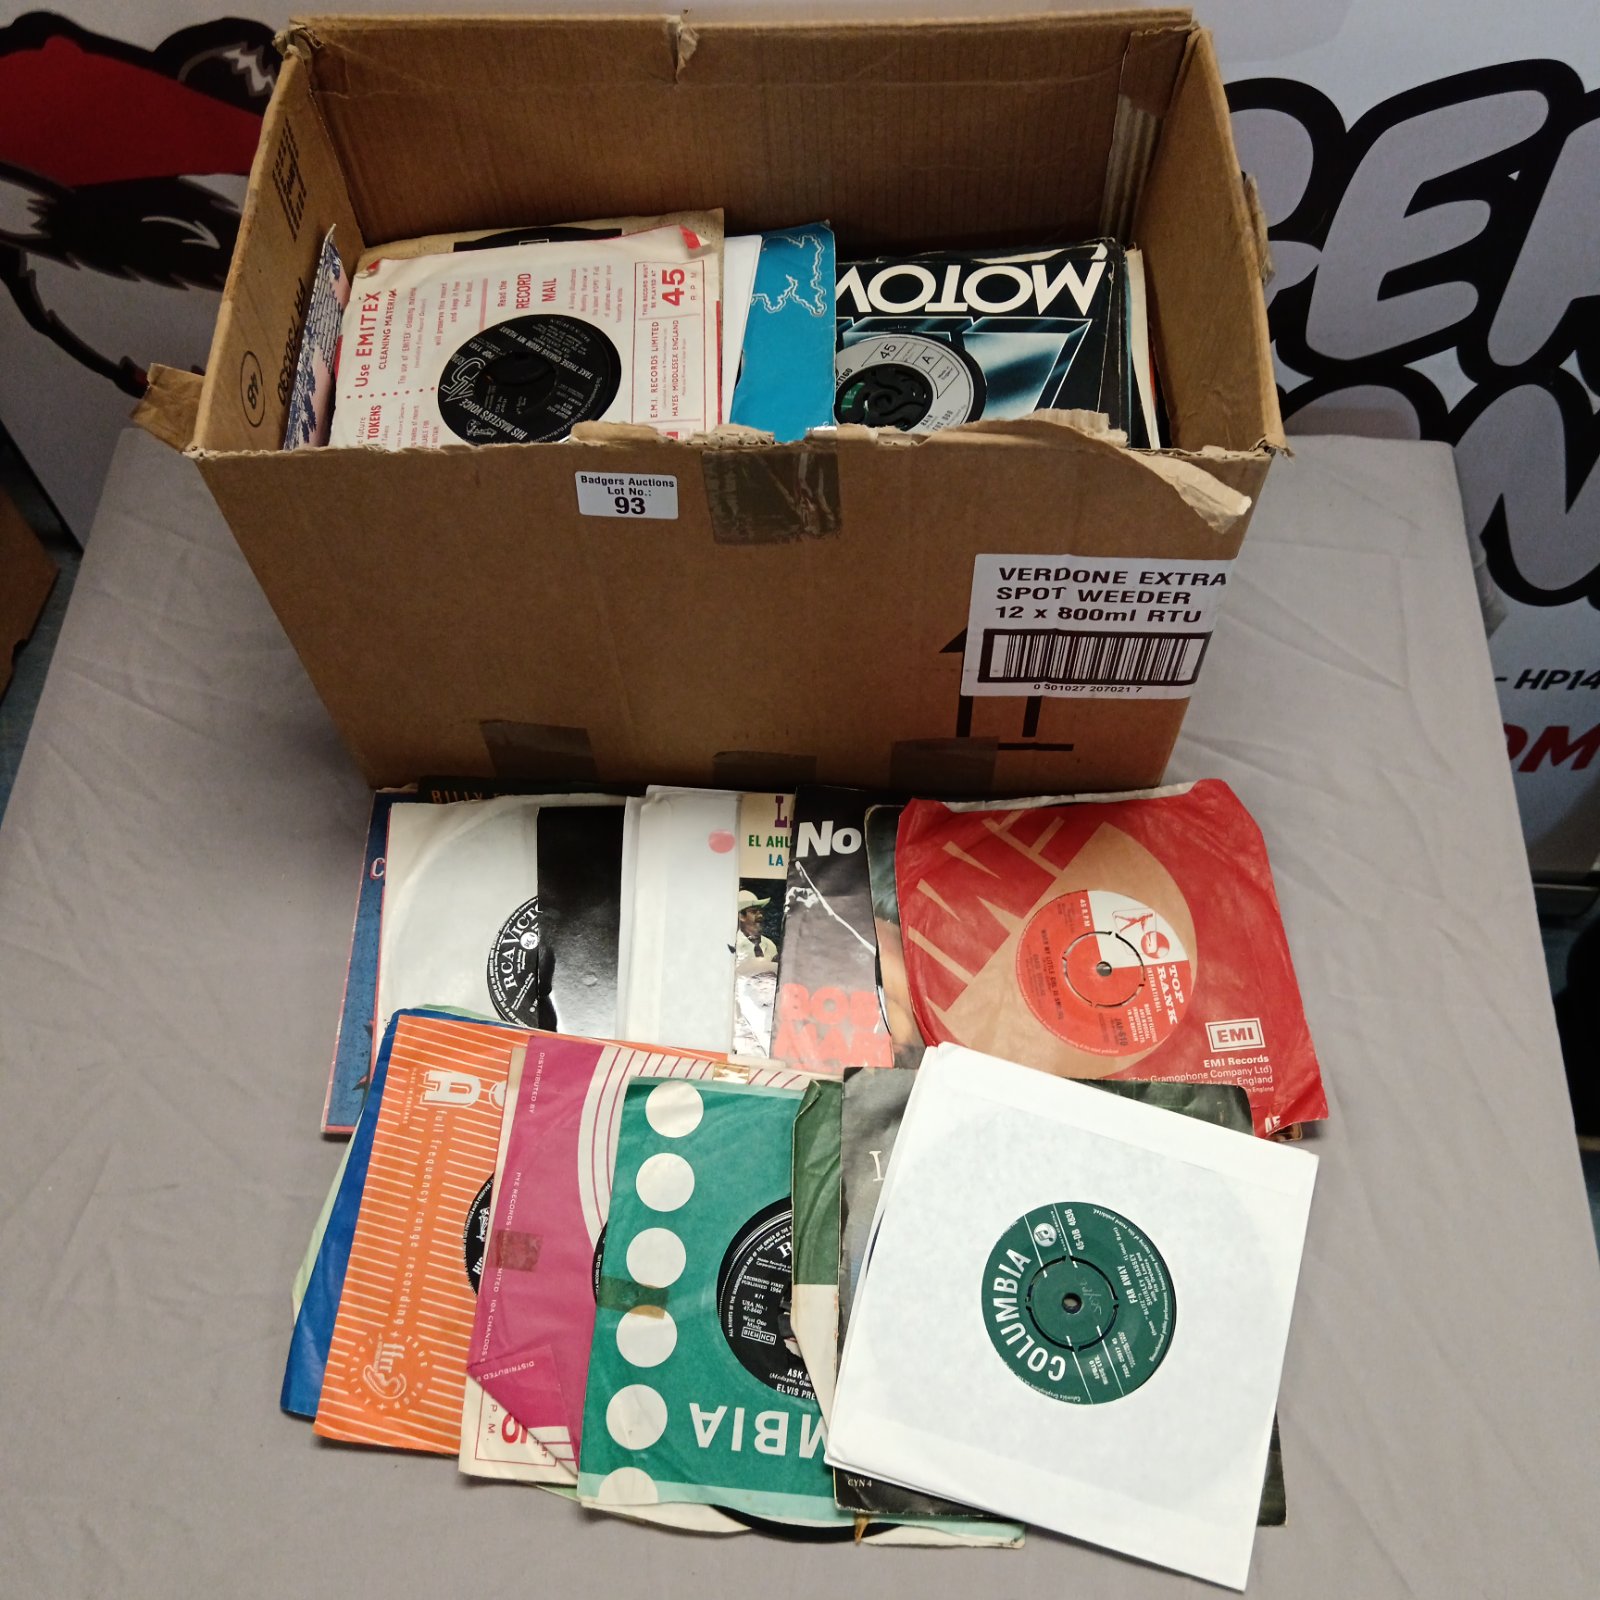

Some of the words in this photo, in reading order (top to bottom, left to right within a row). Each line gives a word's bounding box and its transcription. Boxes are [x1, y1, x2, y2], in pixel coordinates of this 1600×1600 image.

[516, 273, 532, 309] RECORD
[542, 278, 556, 302] MAIL
[662, 268, 685, 306] 45
[498, 292, 506, 307] Read
[356, 291, 382, 357] EMITEX
[378, 328, 392, 370] CLEANING
[880, 344, 896, 359] 45
[922, 355, 934, 364] A
[354, 364, 370, 388] Use
[459, 398, 482, 414] VOICE
[367, 404, 382, 440] TOKENS
[510, 426, 528, 440] HIS
[580, 475, 624, 486] Badgers
[628, 478, 674, 488] Auctions
[608, 486, 624, 495] Lot
[629, 488, 652, 496] No.:
[614, 496, 646, 514] 93
[998, 567, 1128, 585] VERDONE
[1139, 571, 1227, 586] EXTRA
[996, 586, 1066, 600] SPOT
[1078, 589, 1191, 605] WEEDER
[995, 606, 1023, 619] 12
[1034, 608, 1046, 619] x
[1058, 607, 1136, 622] 800ml
[1148, 610, 1202, 623] RTU
[1044, 684, 1086, 692] 501027
[1514, 669, 1600, 690] HP14
[748, 835, 761, 847] EL
[796, 820, 862, 858] No
[768, 854, 784, 866] LA
[1080, 898, 1086, 908] 45
[501, 947, 518, 990] RCA
[1146, 968, 1162, 1012] INTERNATIONAL
[1169, 965, 1184, 1004] TOP
[1157, 967, 1178, 1024] RANK
[1216, 1028, 1254, 1043] EMI
[1204, 1060, 1226, 1068] EMI
[1228, 1055, 1269, 1066] Records
[531, 1052, 546, 1102] DISTRIBUTED
[1150, 1071, 1208, 1082] Gramophone
[1210, 1067, 1253, 1078] Company
[1255, 1065, 1272, 1076] Ltd)
[1237, 1075, 1273, 1086] England
[529, 1104, 536, 1113] BY
[433, 1110, 448, 1132] full
[417, 1140, 442, 1204] frequency
[514, 1172, 522, 1188] PYE
[506, 1189, 520, 1226] RECORDS
[410, 1210, 425, 1248] range
[1130, 1254, 1142, 1277] BASSEY
[1144, 1258, 1156, 1283] Orchestra
[493, 1261, 504, 1292] MITED
[744, 1275, 770, 1285] RECORDING
[1117, 1266, 1132, 1286] AWAY
[393, 1256, 416, 1326] recording
[742, 1280, 768, 1290] PUBLISHED
[770, 1286, 782, 1294] 1964
[1126, 1288, 1138, 1304] FAR
[1138, 1279, 1152, 1306] SHIRLEY
[993, 1248, 1066, 1382] COLUMBIA
[482, 1315, 494, 1357] CHANDOS
[761, 1333, 774, 1342] NCB
[379, 1342, 406, 1374] ffrr
[484, 1360, 535, 1380] DISTRIBUTED
[787, 1368, 803, 1380] ASK
[1088, 1360, 1100, 1380] APOLLO
[776, 1384, 799, 1396] ELVIS
[848, 1478, 865, 1487] CYN
